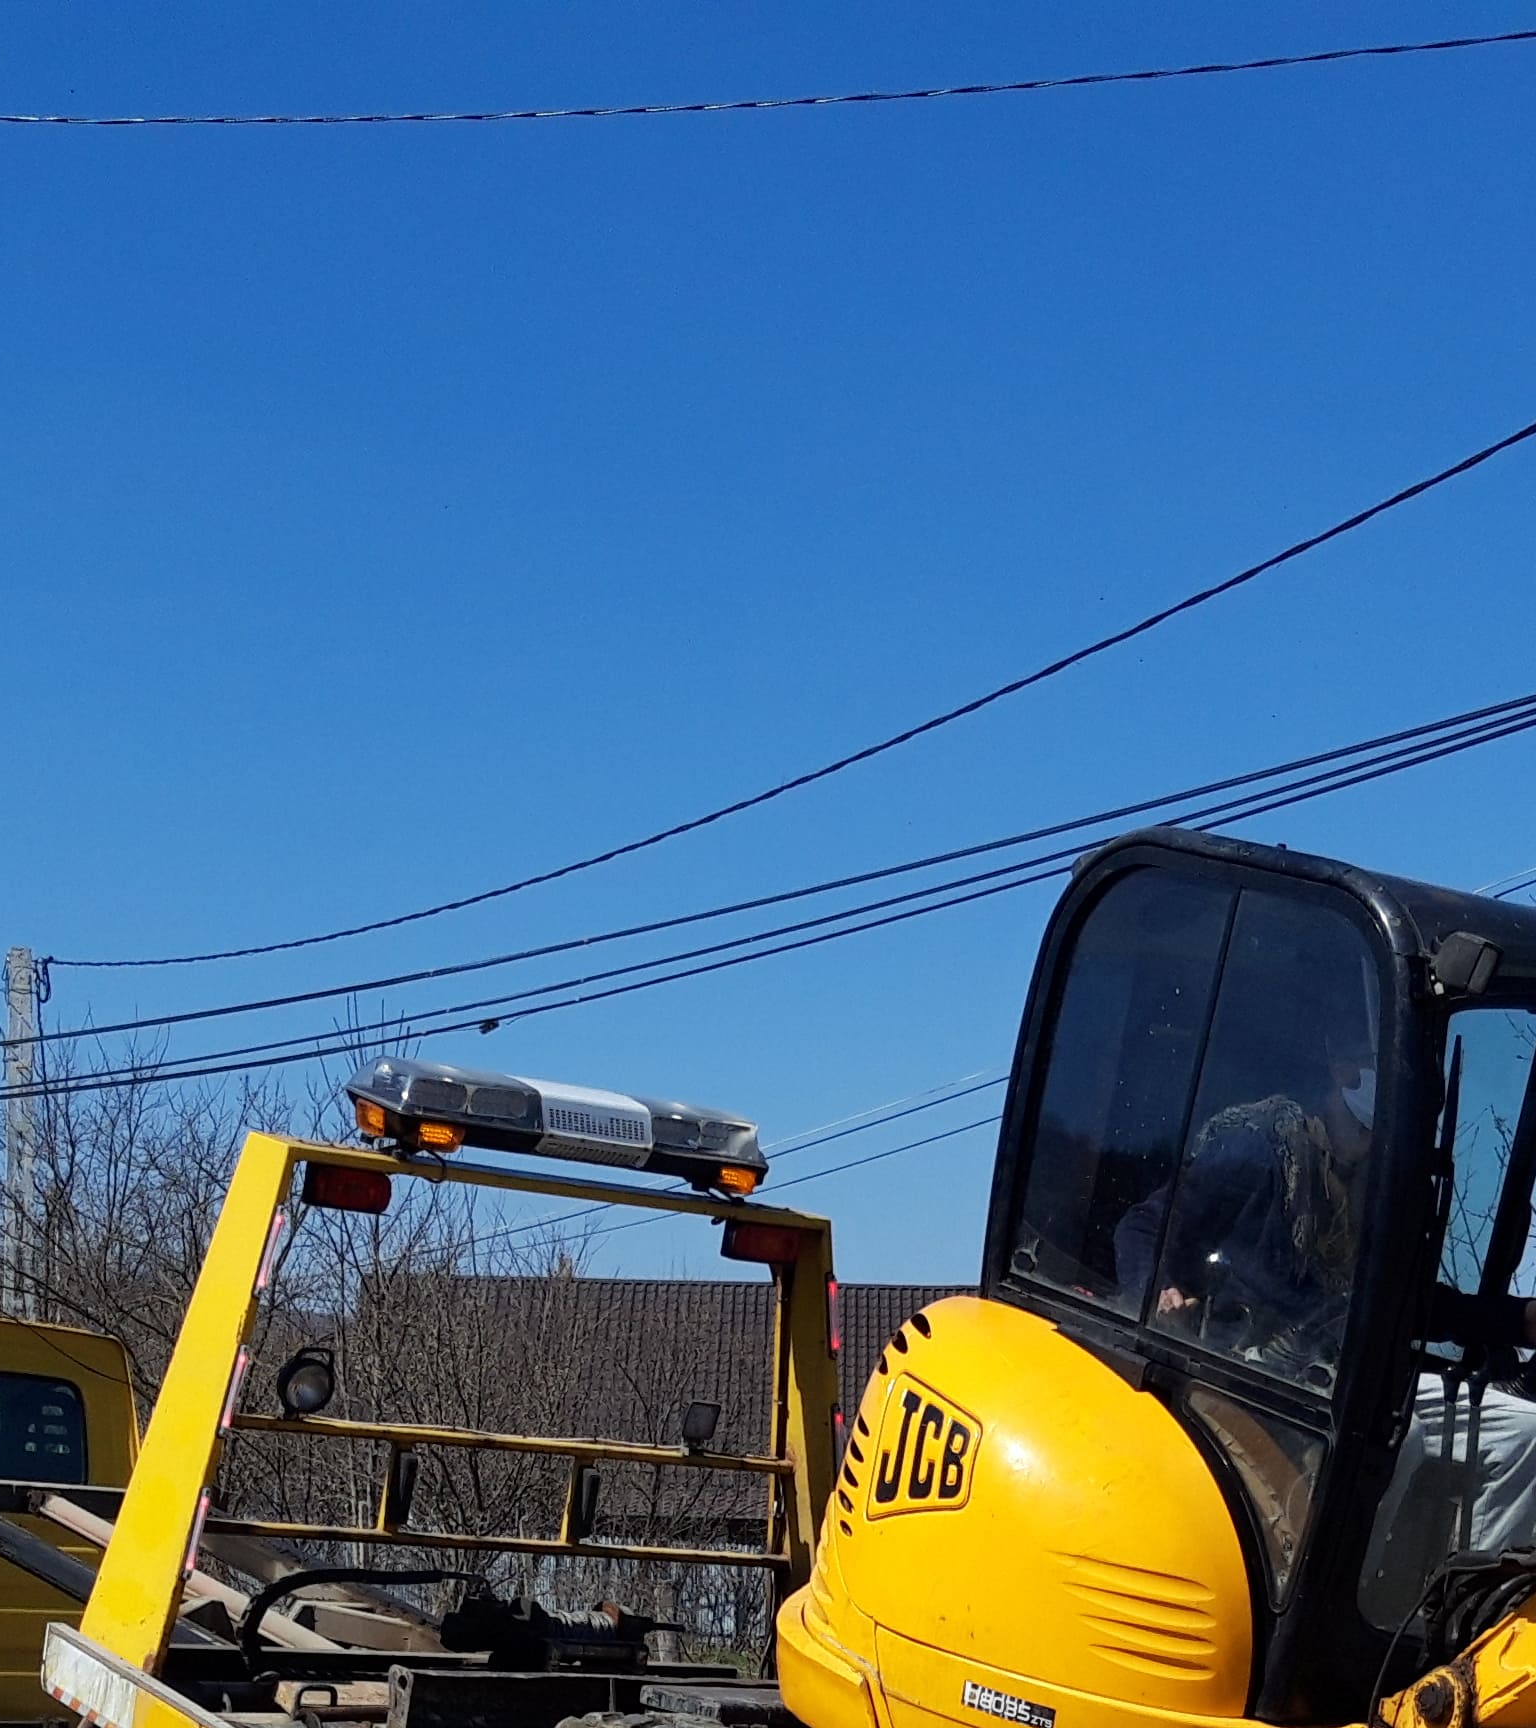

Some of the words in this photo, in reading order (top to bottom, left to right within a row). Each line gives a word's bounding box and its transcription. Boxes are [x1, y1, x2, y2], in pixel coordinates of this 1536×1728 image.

[875, 1389, 971, 1504] JCB
[979, 1690, 1031, 1722] 8035
[1030, 1715, 1053, 1728] ZTS
